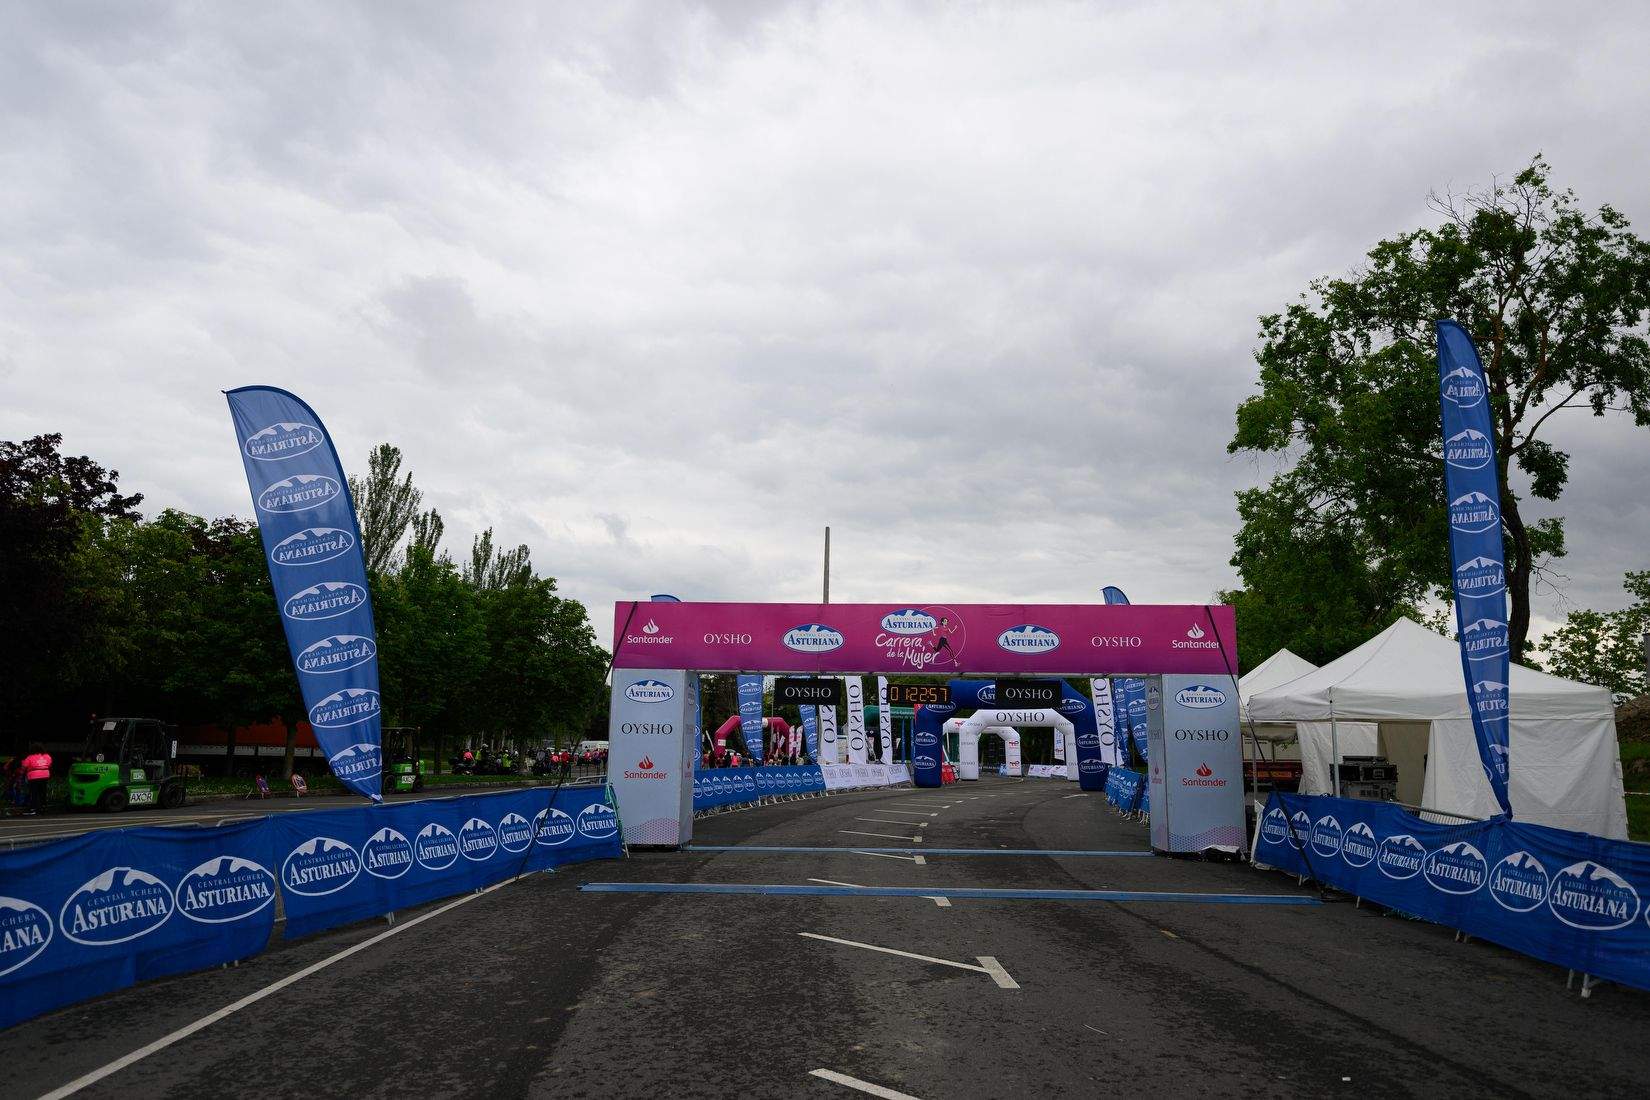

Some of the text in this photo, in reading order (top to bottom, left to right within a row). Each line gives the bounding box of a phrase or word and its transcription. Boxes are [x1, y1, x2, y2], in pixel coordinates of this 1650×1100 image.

[885, 618, 933, 629] ASTURIANA
[627, 634, 673, 646] Santander
[703, 633, 752, 645] OYSHO
[787, 634, 840, 646] ASTURIANA
[875, 633, 923, 648] Carrera
[1002, 635, 1056, 647] ASTURIANA
[1092, 636, 1142, 648] OYSHO
[1172, 638, 1220, 649] Santander
[886, 645, 940, 670] de la Mujer
[628, 687, 671, 698] ASTURIANA
[785, 686, 832, 698] OYSHO
[1005, 687, 1053, 700] OYSHO
[1178, 693, 1223, 704] ASTURIANA
[996, 711, 1045, 723] OYSHO
[621, 722, 673, 735] OYSHO
[1175, 729, 1229, 742] OYSHO
[624, 769, 668, 780] Santander
[1182, 778, 1227, 787] Santander
[131, 792, 152, 802] AXOR
[419, 842, 457, 861] ASTURIANA
[368, 848, 411, 869] ASTURIANA
[289, 858, 358, 887] ASTURIANA
[1426, 855, 1481, 886] ASTURIANA
[197, 877, 231, 889] CENTRAL
[1492, 868, 1542, 901] ASTURIANA
[87, 892, 126, 908] CENTRAL
[184, 881, 271, 911] ASTURIANA
[1551, 880, 1629, 920] ASTURIANA
[71, 896, 168, 935] ASTURANA
